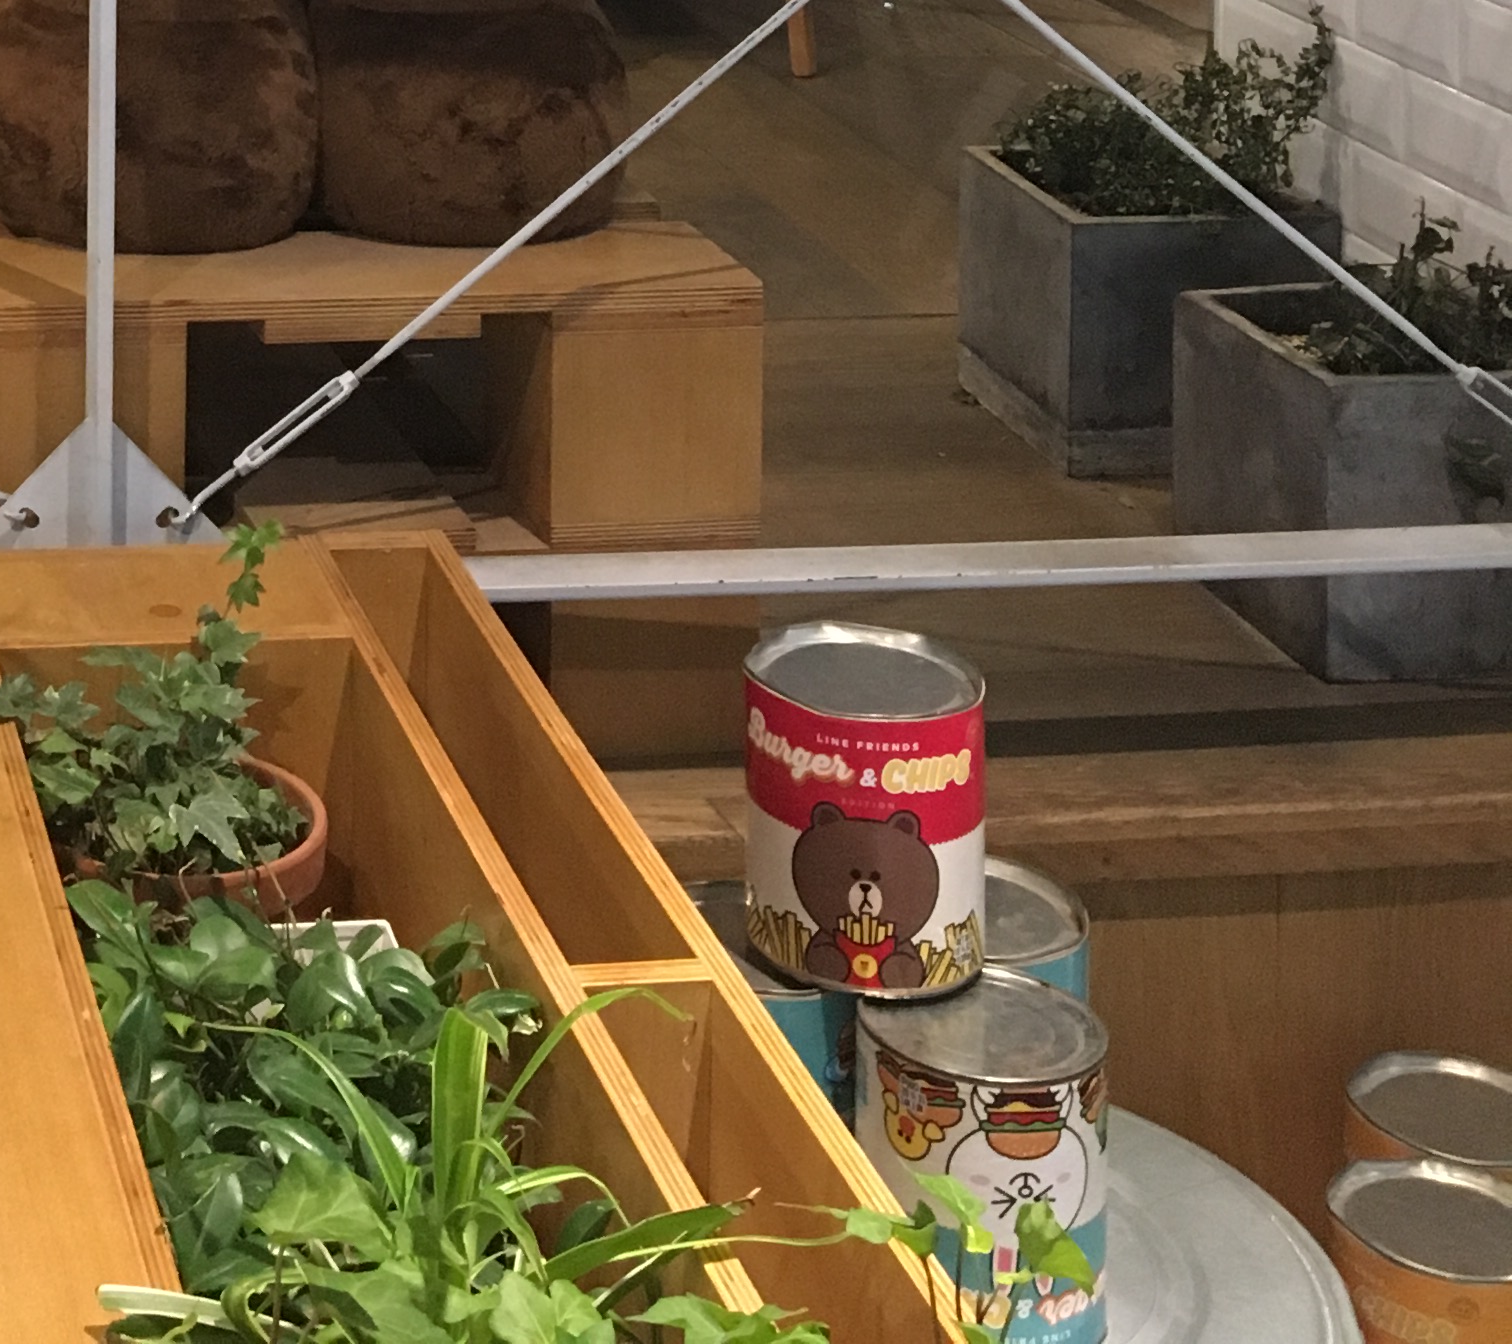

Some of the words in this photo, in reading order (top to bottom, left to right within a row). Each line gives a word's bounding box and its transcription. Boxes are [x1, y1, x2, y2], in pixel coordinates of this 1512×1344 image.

[748, 706, 855, 783] Burger
[859, 768, 878, 788] &
[881, 748, 972, 794] CHIPS
[816, 732, 849, 749] LINE
[856, 740, 920, 752] FRIENDS
